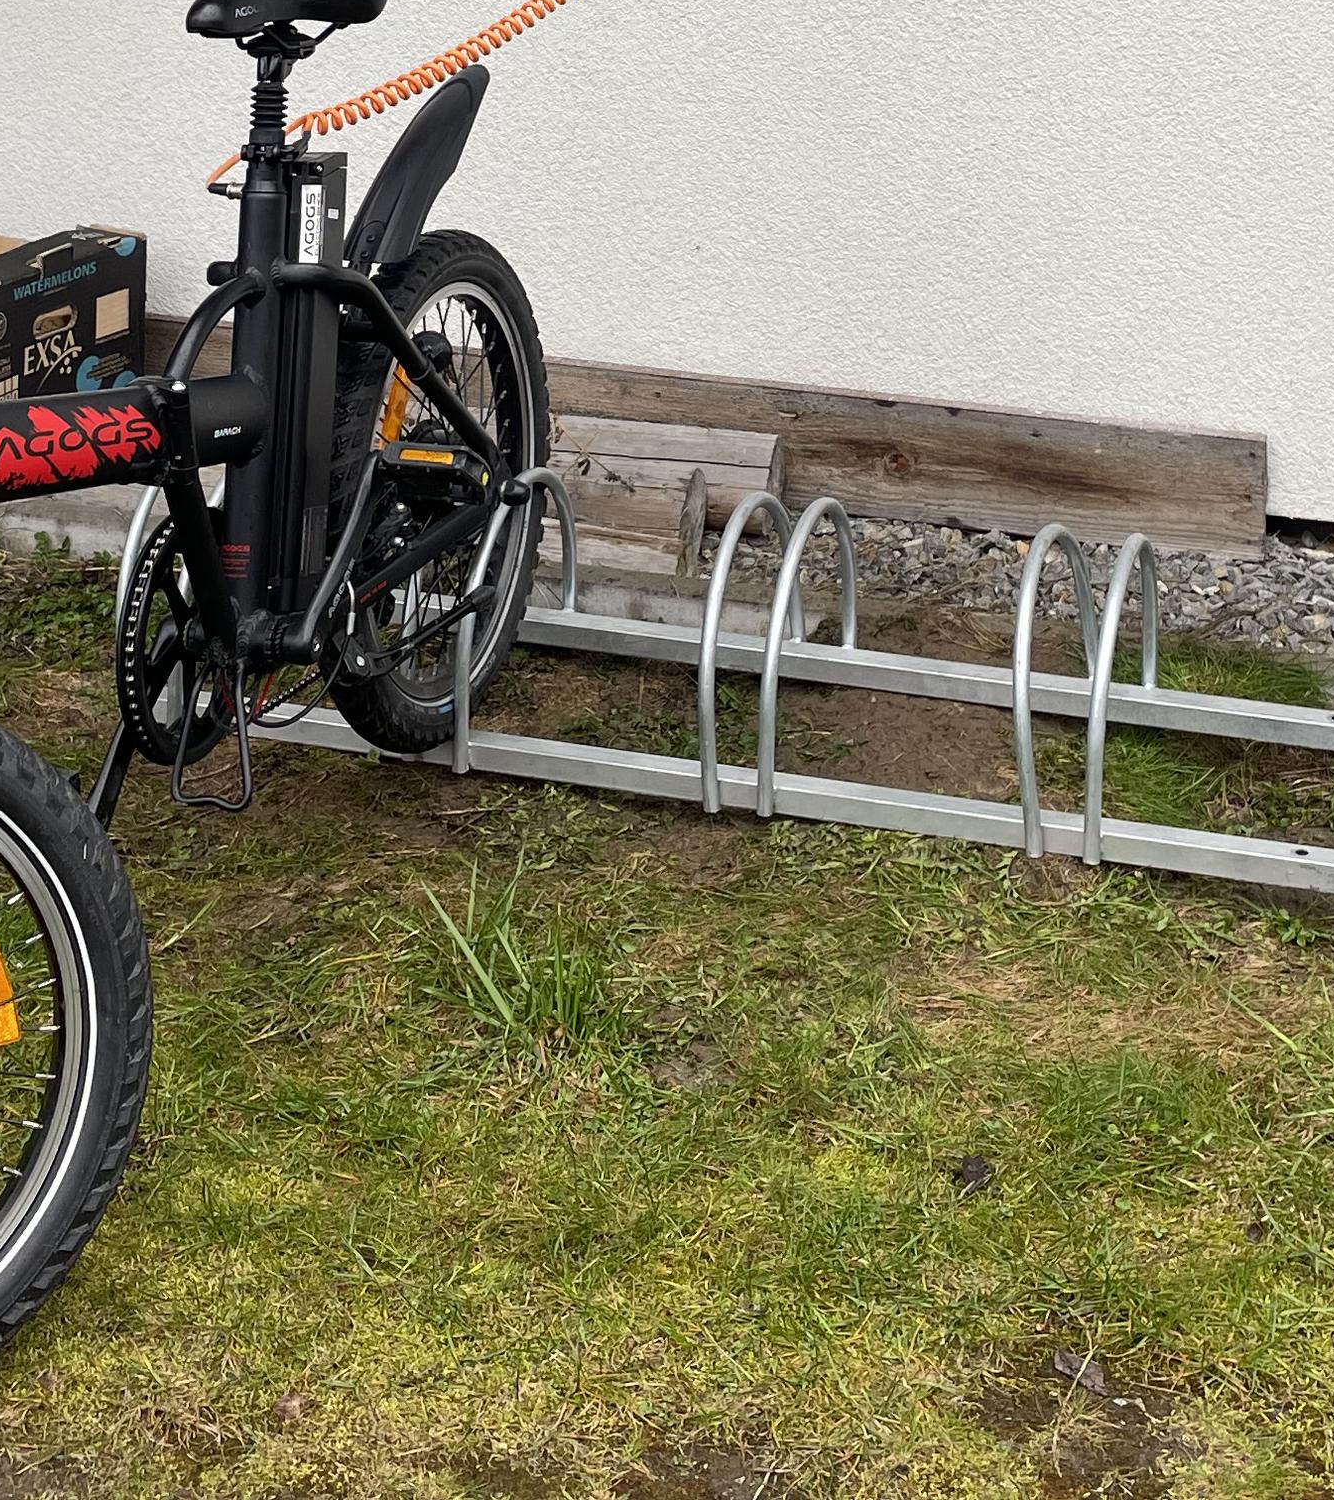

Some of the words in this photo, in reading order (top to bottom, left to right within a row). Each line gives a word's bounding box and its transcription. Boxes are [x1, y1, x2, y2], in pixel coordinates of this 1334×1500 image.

[303, 193, 317, 257] AGOGS
[11, 261, 98, 301] WATERMELONS
[23, 329, 82, 377] EXSA
